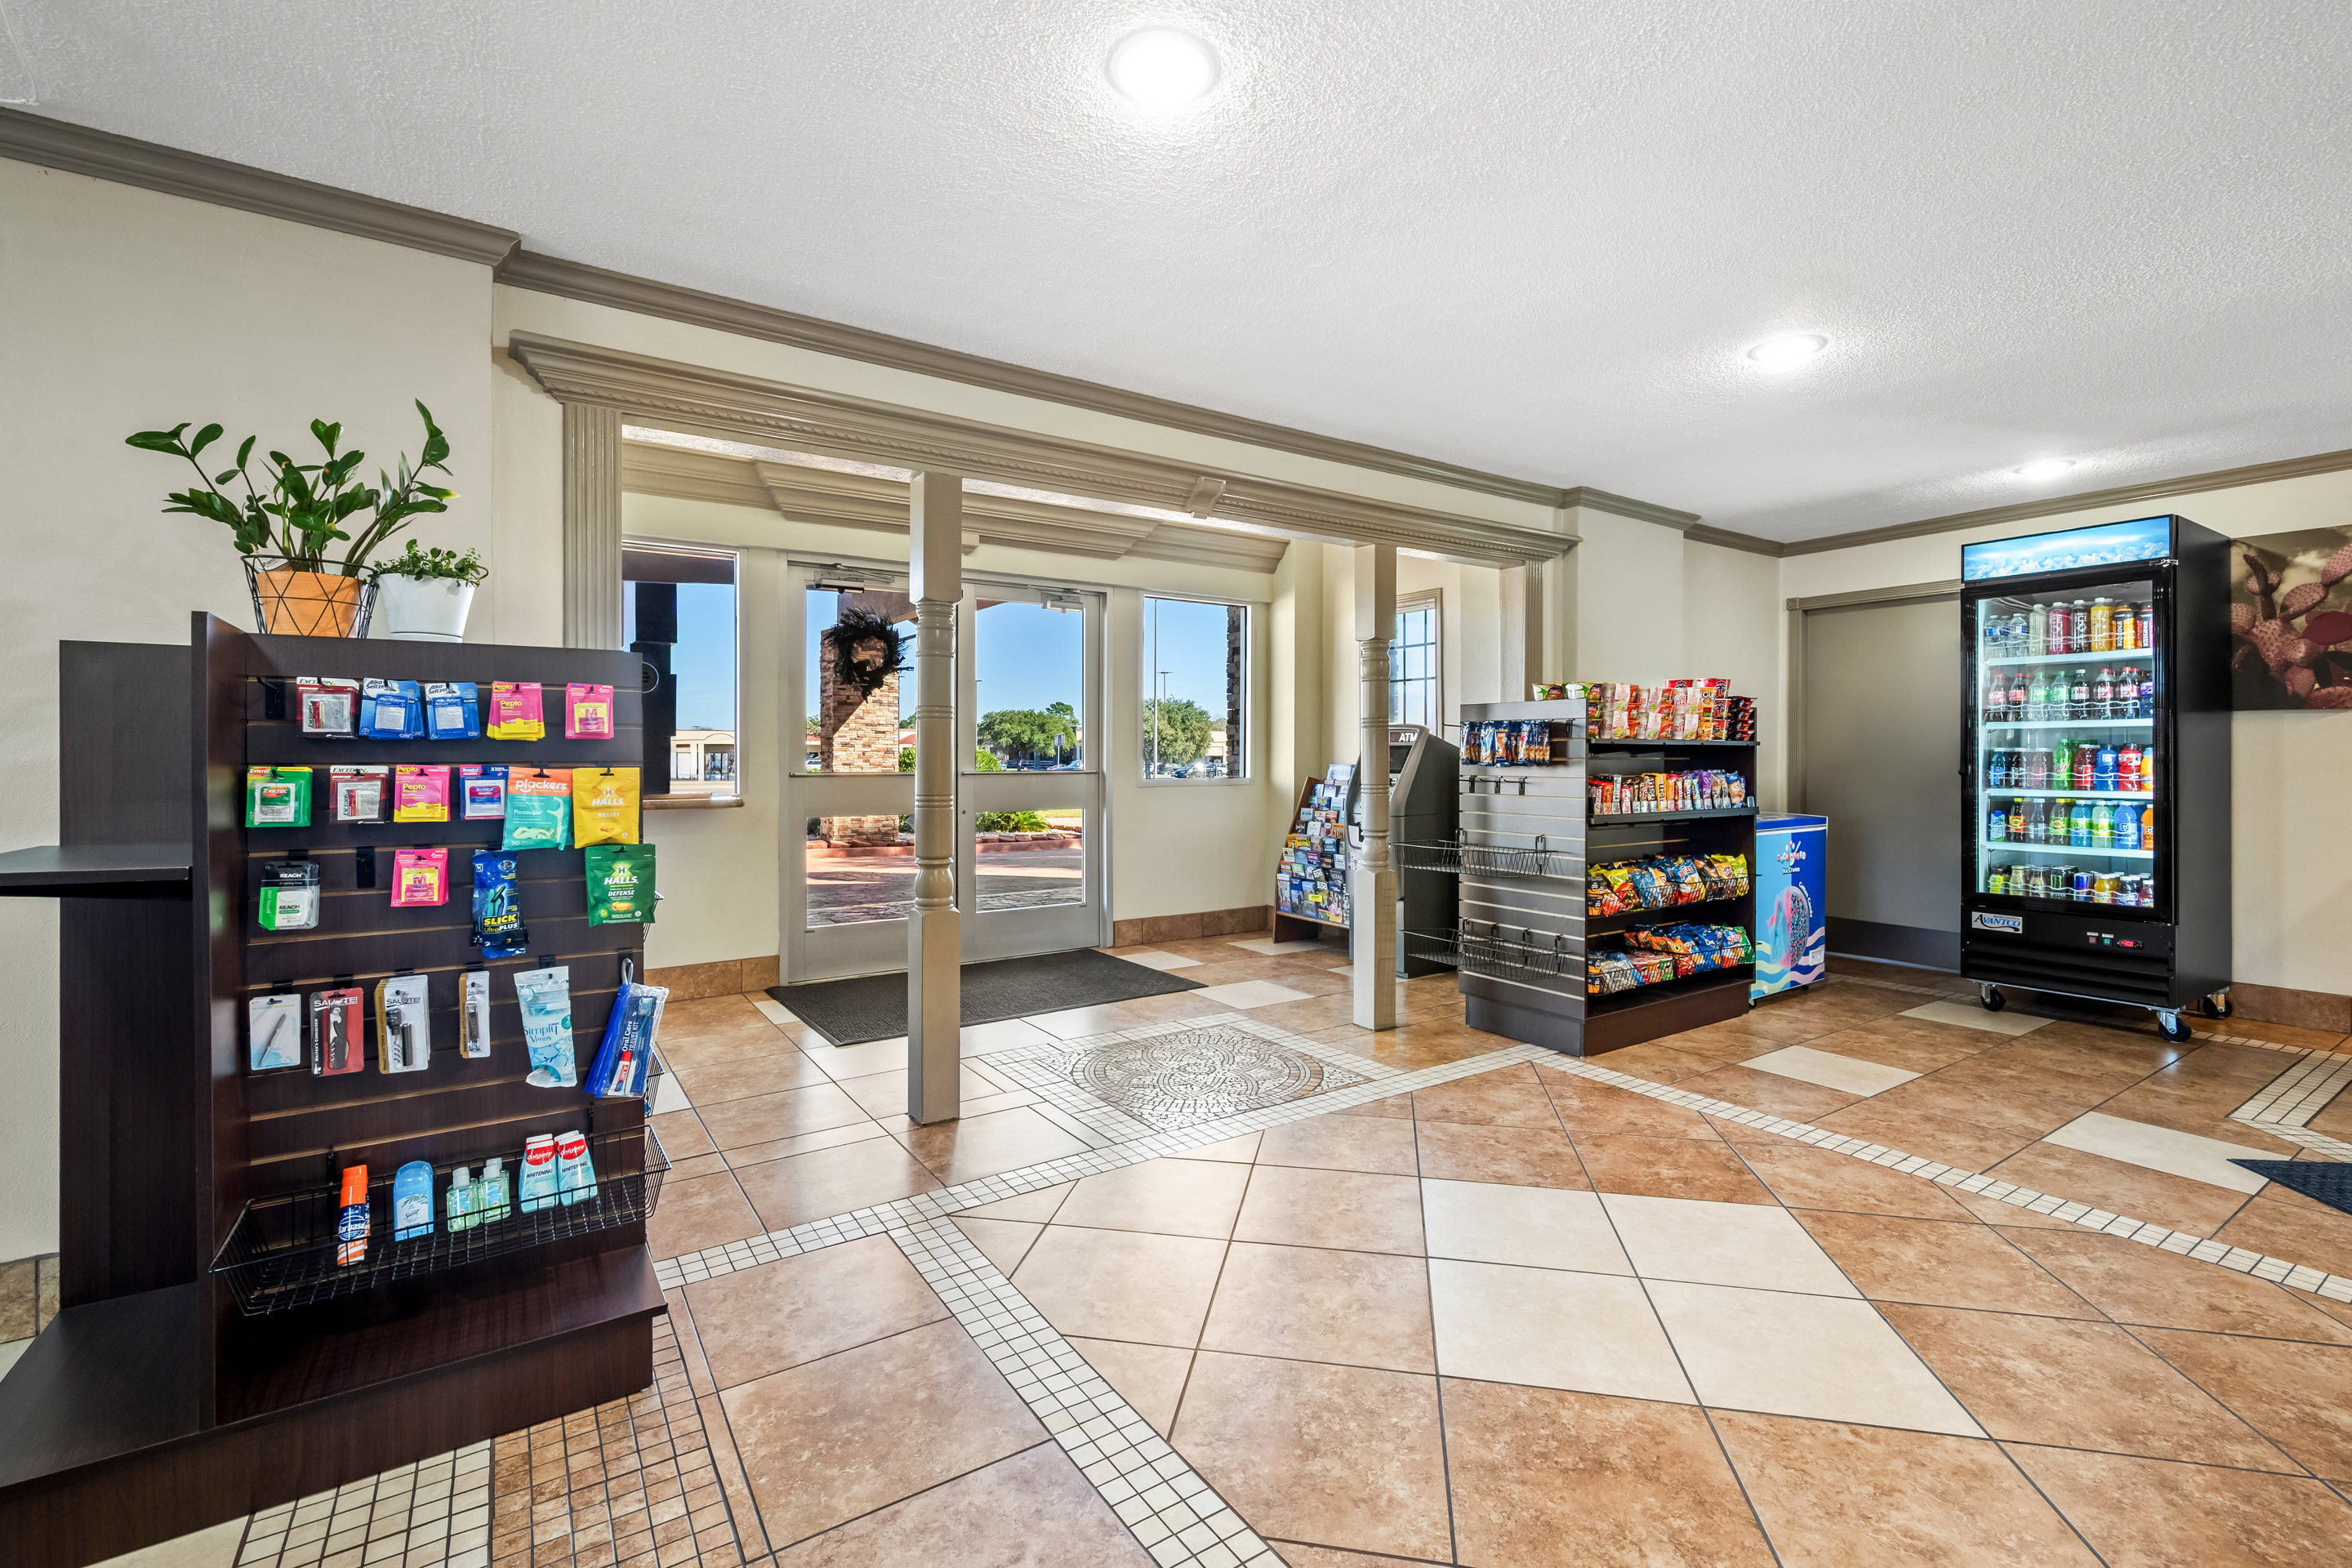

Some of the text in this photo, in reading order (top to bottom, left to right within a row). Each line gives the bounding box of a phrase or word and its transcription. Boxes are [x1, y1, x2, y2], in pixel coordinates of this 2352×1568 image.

[1398, 732, 1418, 742] ATM
[514, 778, 567, 792] plackers
[591, 798, 623, 806] HALLS
[604, 875, 637, 885] HALLS
[1798, 881, 1809, 898] Cotton
[483, 913, 517, 926] SLICK
[1974, 914, 2020, 928] AVANTCO
[314, 997, 359, 1007] SALUTE!
[565, 1016, 570, 1024] 2
[621, 1021, 633, 1052] Oral Care
[629, 1031, 639, 1052] TRAVEL
[527, 1151, 553, 1161] Colgate
[526, 1168, 553, 1179] WHITENING
